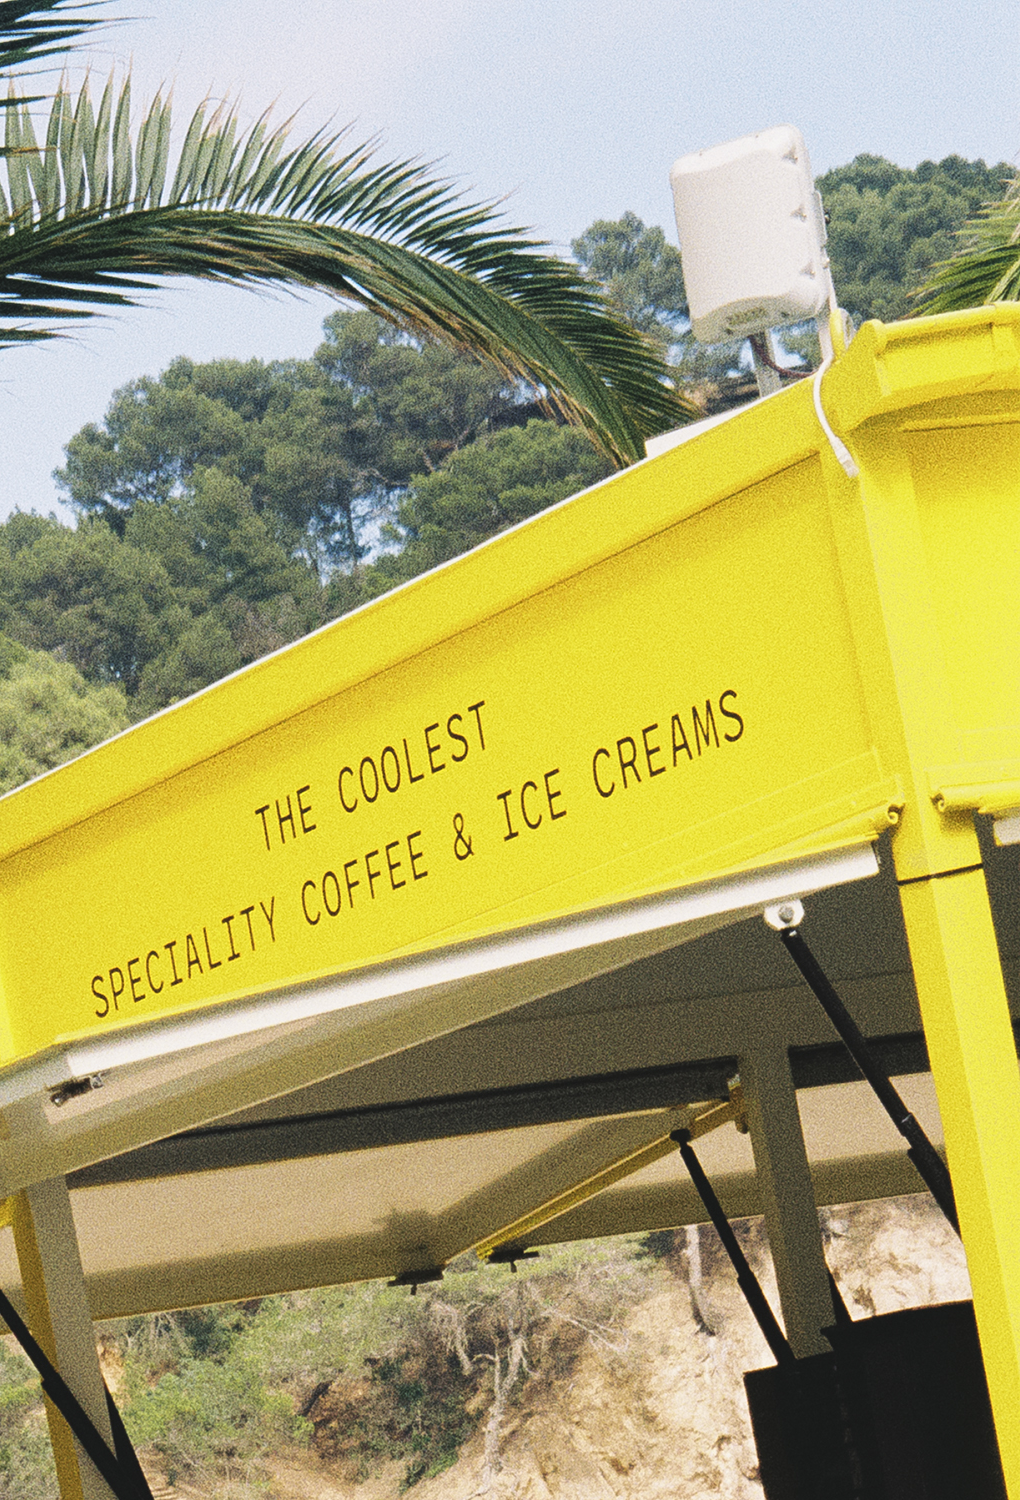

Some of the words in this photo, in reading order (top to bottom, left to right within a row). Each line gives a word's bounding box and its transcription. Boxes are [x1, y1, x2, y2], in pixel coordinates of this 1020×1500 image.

[91, 897, 277, 1019] SPECIALITY
[302, 831, 429, 925] COFFEE
[453, 814, 474, 861] &
[498, 768, 567, 842] ICE
[592, 690, 745, 798] CREAMS
[255, 785, 316, 852] THE
[338, 700, 487, 813] COOLEST
